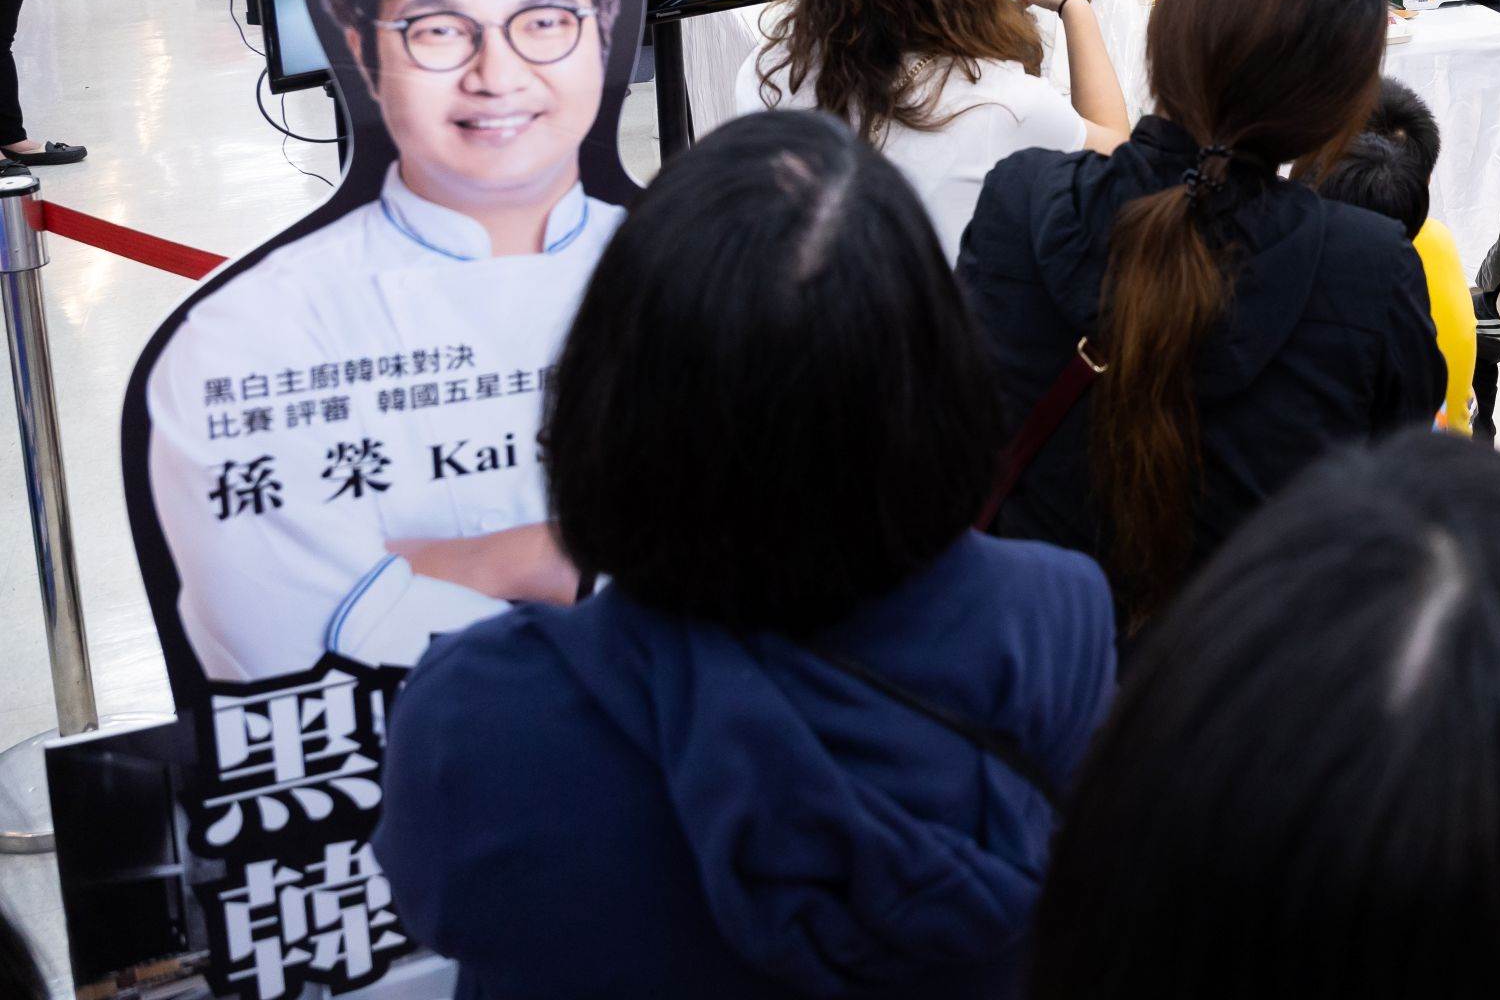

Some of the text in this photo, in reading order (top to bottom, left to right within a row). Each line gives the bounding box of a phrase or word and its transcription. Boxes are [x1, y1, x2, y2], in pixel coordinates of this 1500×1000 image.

[204, 344, 475, 405] 黑白主廚韓味對決
[207, 406, 274, 441] 比賽
[285, 395, 351, 429] 評審
[430, 433, 518, 480] Kai
[203, 669, 388, 847] 黑
